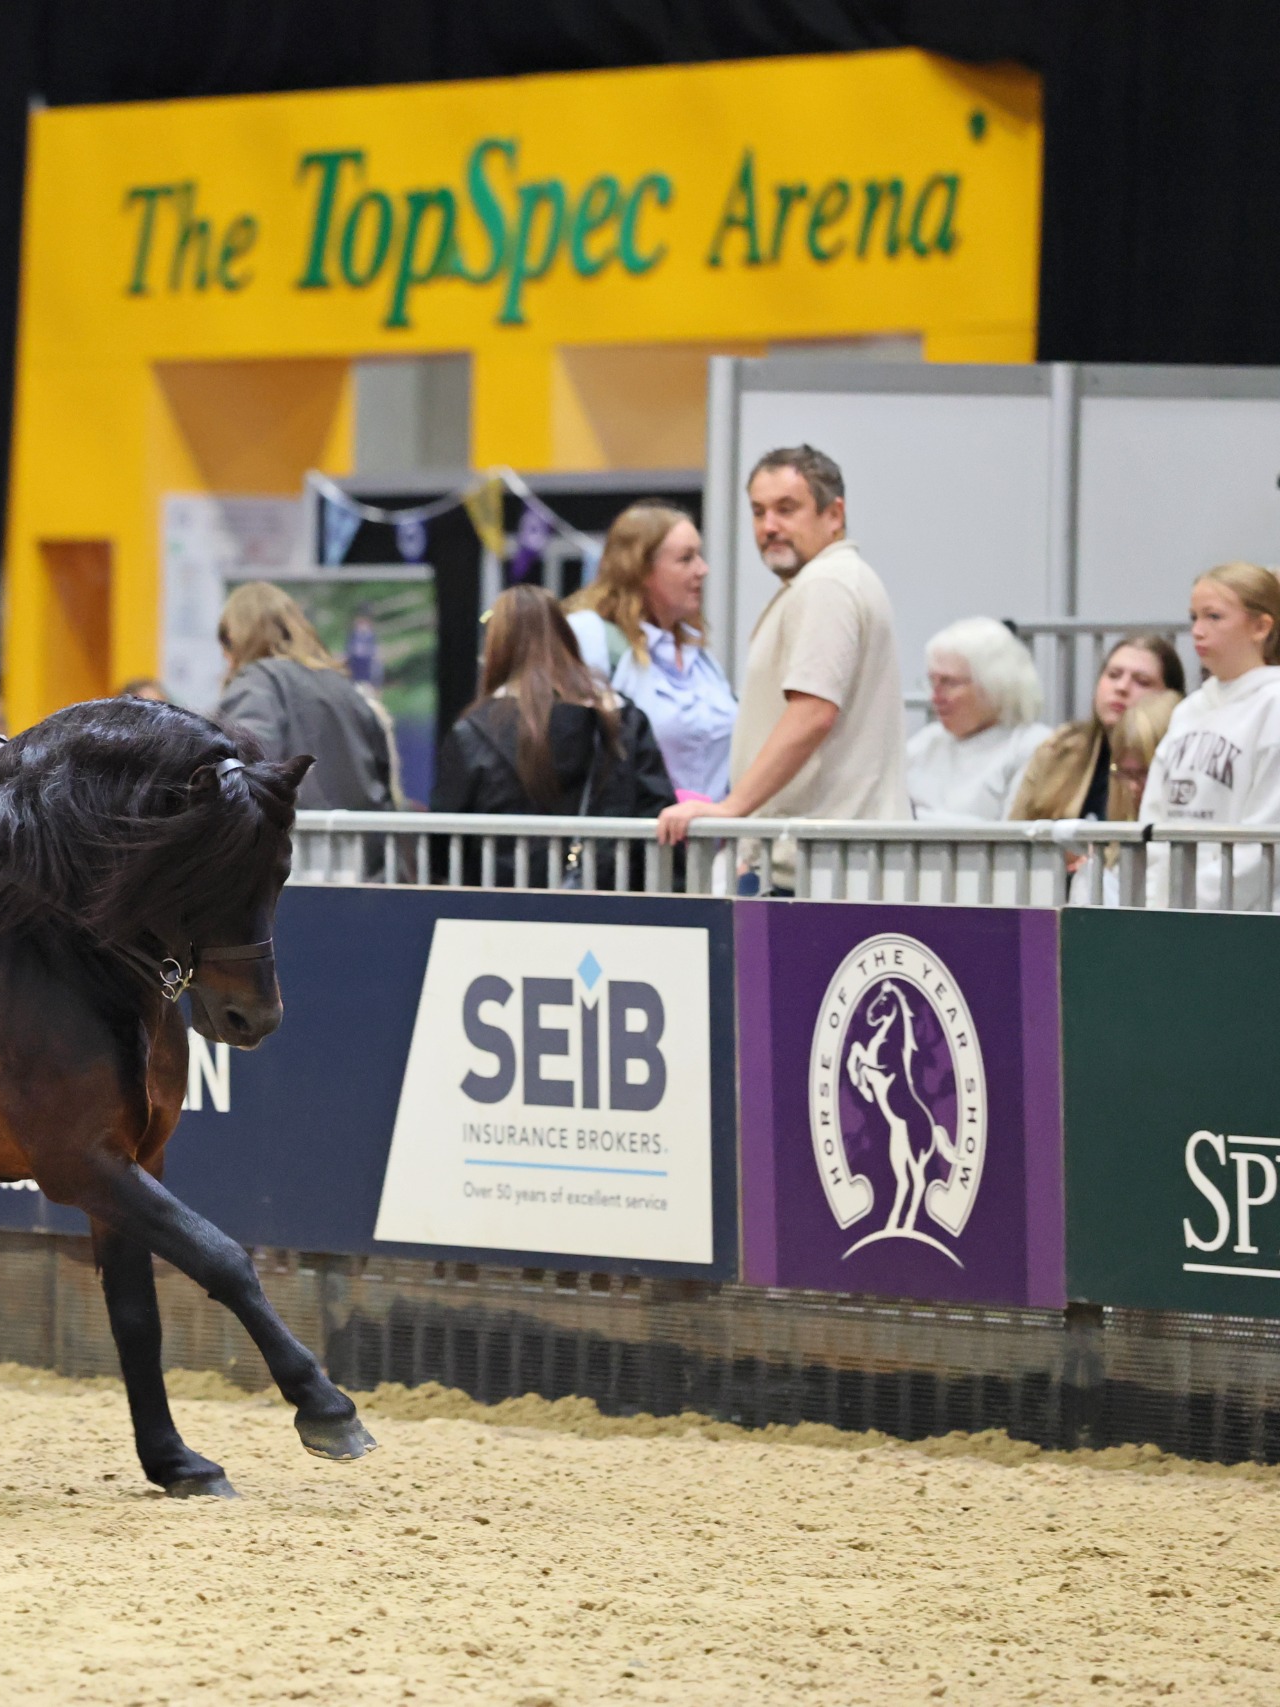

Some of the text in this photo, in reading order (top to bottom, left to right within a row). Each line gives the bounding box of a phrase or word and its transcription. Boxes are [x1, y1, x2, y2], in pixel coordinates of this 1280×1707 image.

[124, 138, 962, 330] The TopSpec Arena
[459, 973, 668, 1112] SEIB
[819, 949, 979, 1190] HORSE OF THE YEAR SHOW
[462, 1122, 569, 1150] INSURANCE
[463, 1180, 668, 1212] Over 50 years of excellent service
